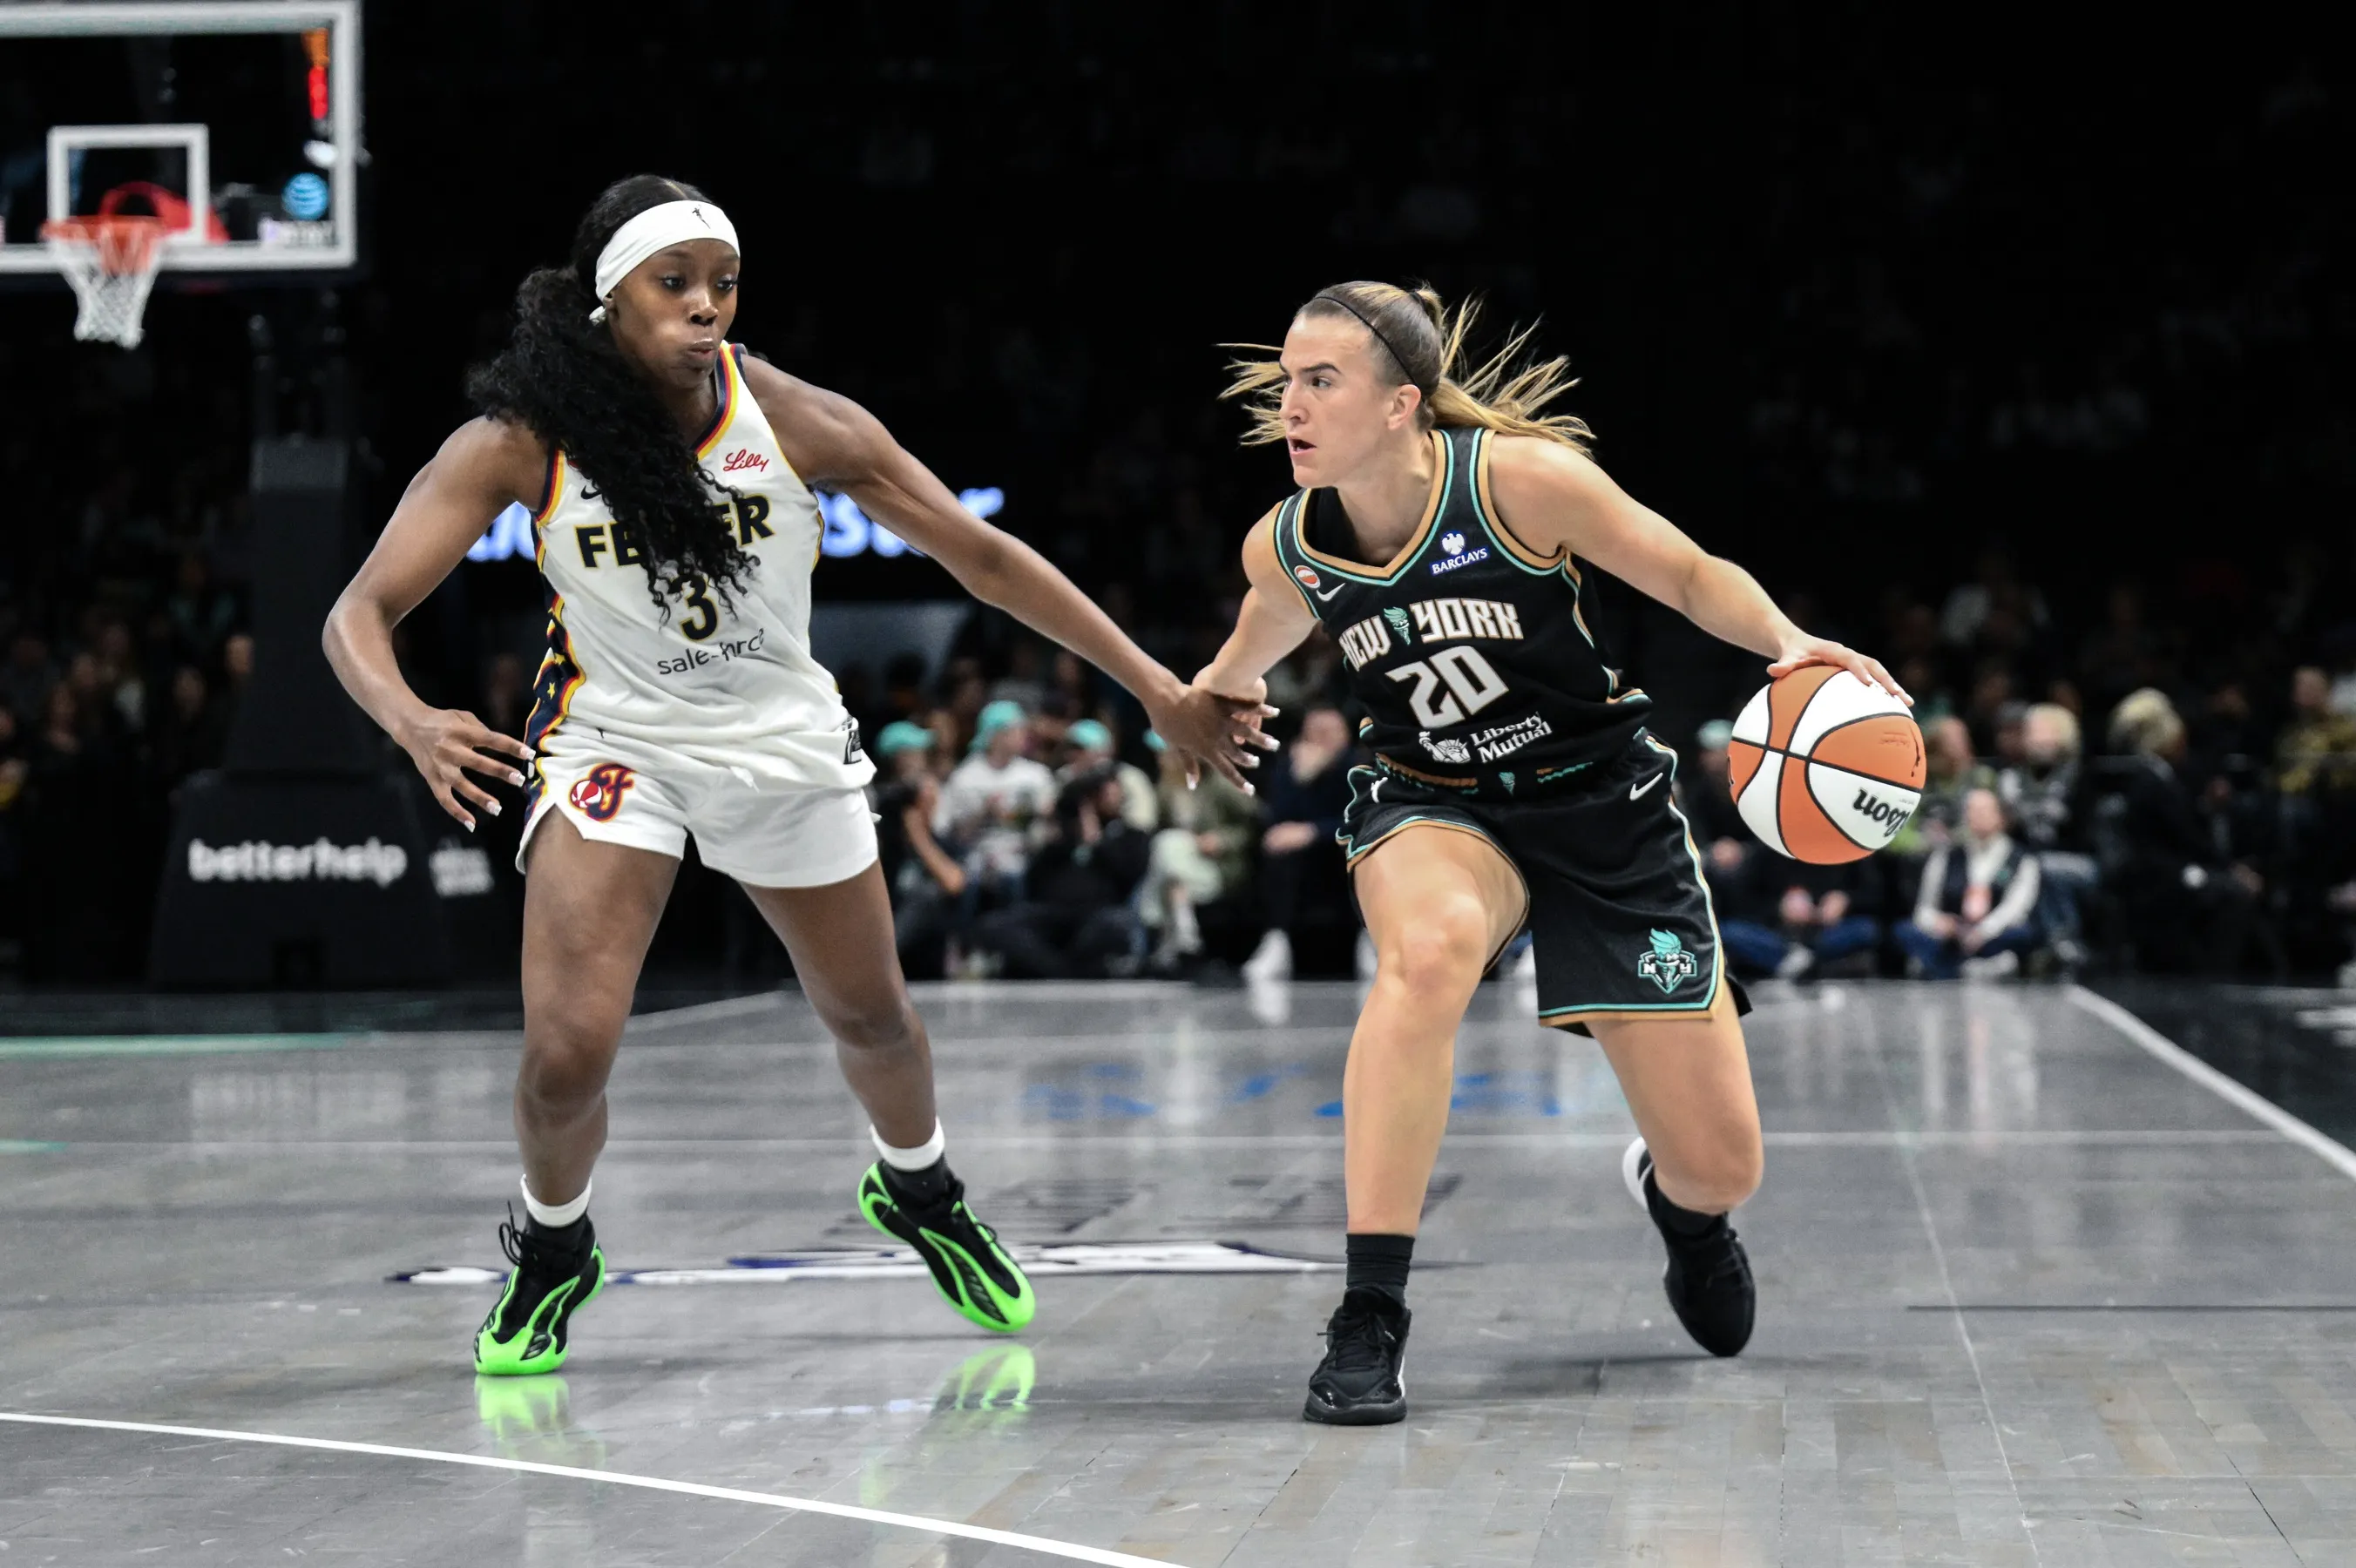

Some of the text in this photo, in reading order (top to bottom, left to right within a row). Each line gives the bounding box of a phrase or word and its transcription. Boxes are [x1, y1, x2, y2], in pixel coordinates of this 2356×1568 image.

[722, 449, 770, 473] Lilly
[574, 493, 777, 568] FER
[1432, 547, 1488, 575] BARCLAYS
[670, 571, 721, 642] 3
[1338, 598, 1524, 672] NEW YORK
[1384, 645, 1509, 729] 20
[1469, 711, 1542, 747] Liberty
[1477, 720, 1552, 763] Mutual
[188, 836, 407, 888] betterhelp
